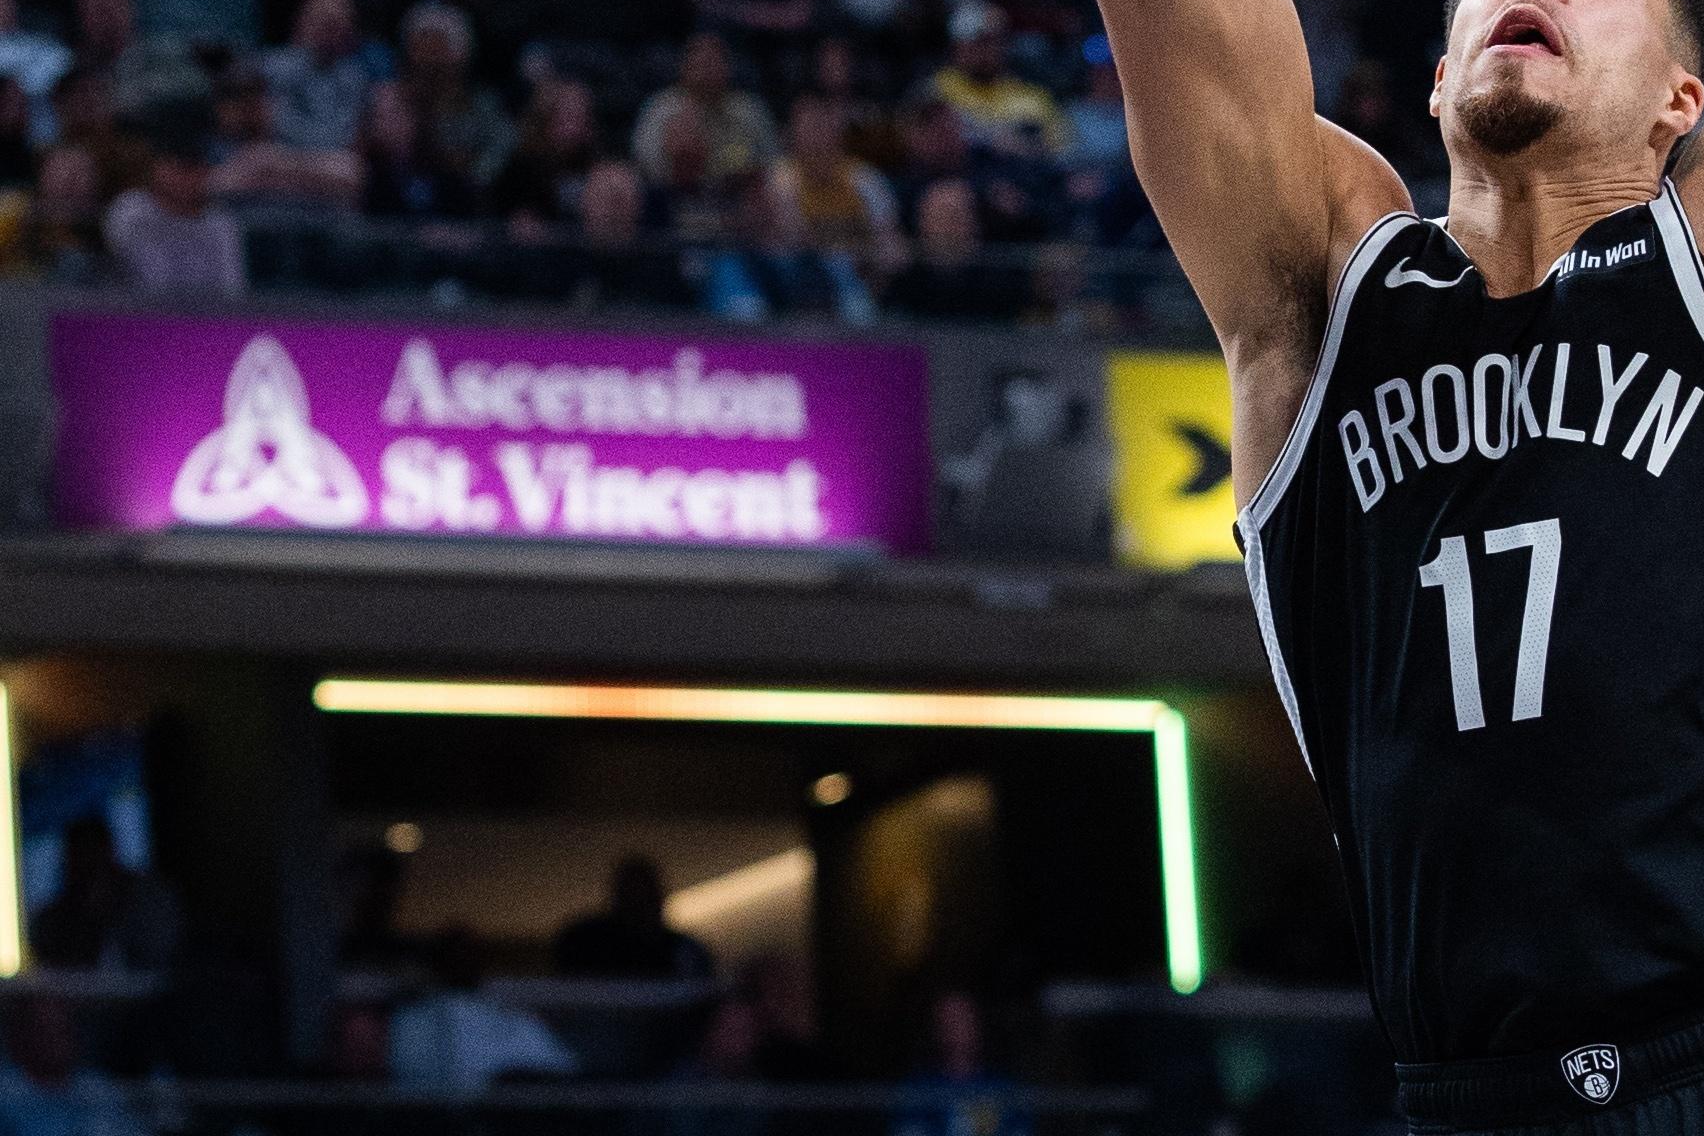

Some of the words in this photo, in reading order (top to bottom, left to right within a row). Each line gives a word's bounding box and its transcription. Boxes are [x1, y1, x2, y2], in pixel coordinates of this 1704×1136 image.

[1580, 250, 1601, 269] In
[1605, 239, 1647, 267] Won
[381, 337, 806, 441] Ascension
[1338, 342, 1704, 513] BROOKLYN
[380, 436, 500, 532] St.
[497, 440, 828, 540] Vincent
[1418, 517, 1562, 732] 17
[1566, 1049, 1615, 1080] NETS
